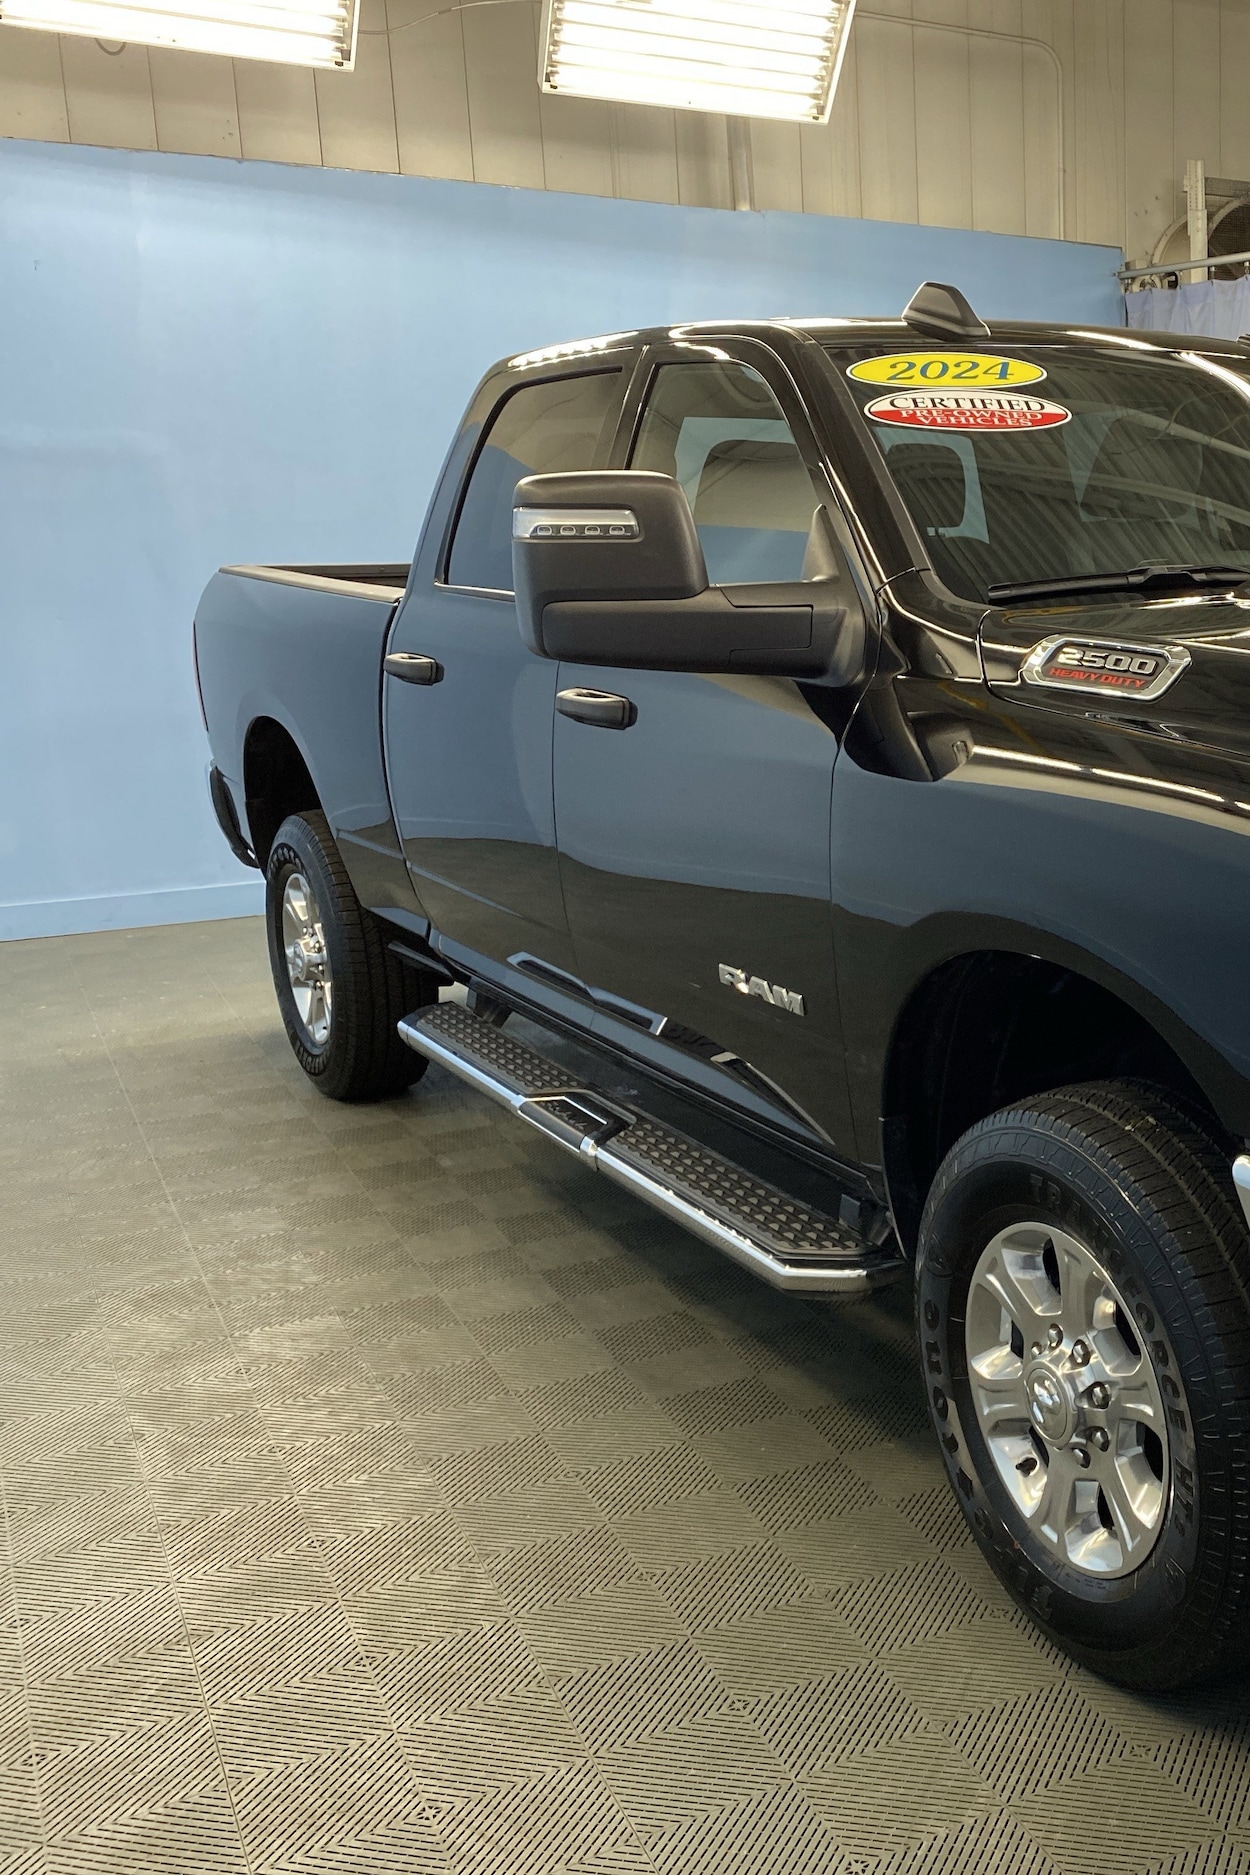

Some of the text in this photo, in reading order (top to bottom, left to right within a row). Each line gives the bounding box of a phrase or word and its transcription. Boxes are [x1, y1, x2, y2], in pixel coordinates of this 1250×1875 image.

[886, 360, 1015, 381] 2024
[889, 397, 1046, 412] CERTIFIED
[900, 409, 1043, 420] PRE-OWNED
[917, 416, 1033, 426] VEHICLES
[1056, 647, 1157, 675] 2500
[1049, 668, 1147, 689] HEAVY DUTY
[718, 962, 805, 1017] RAM
